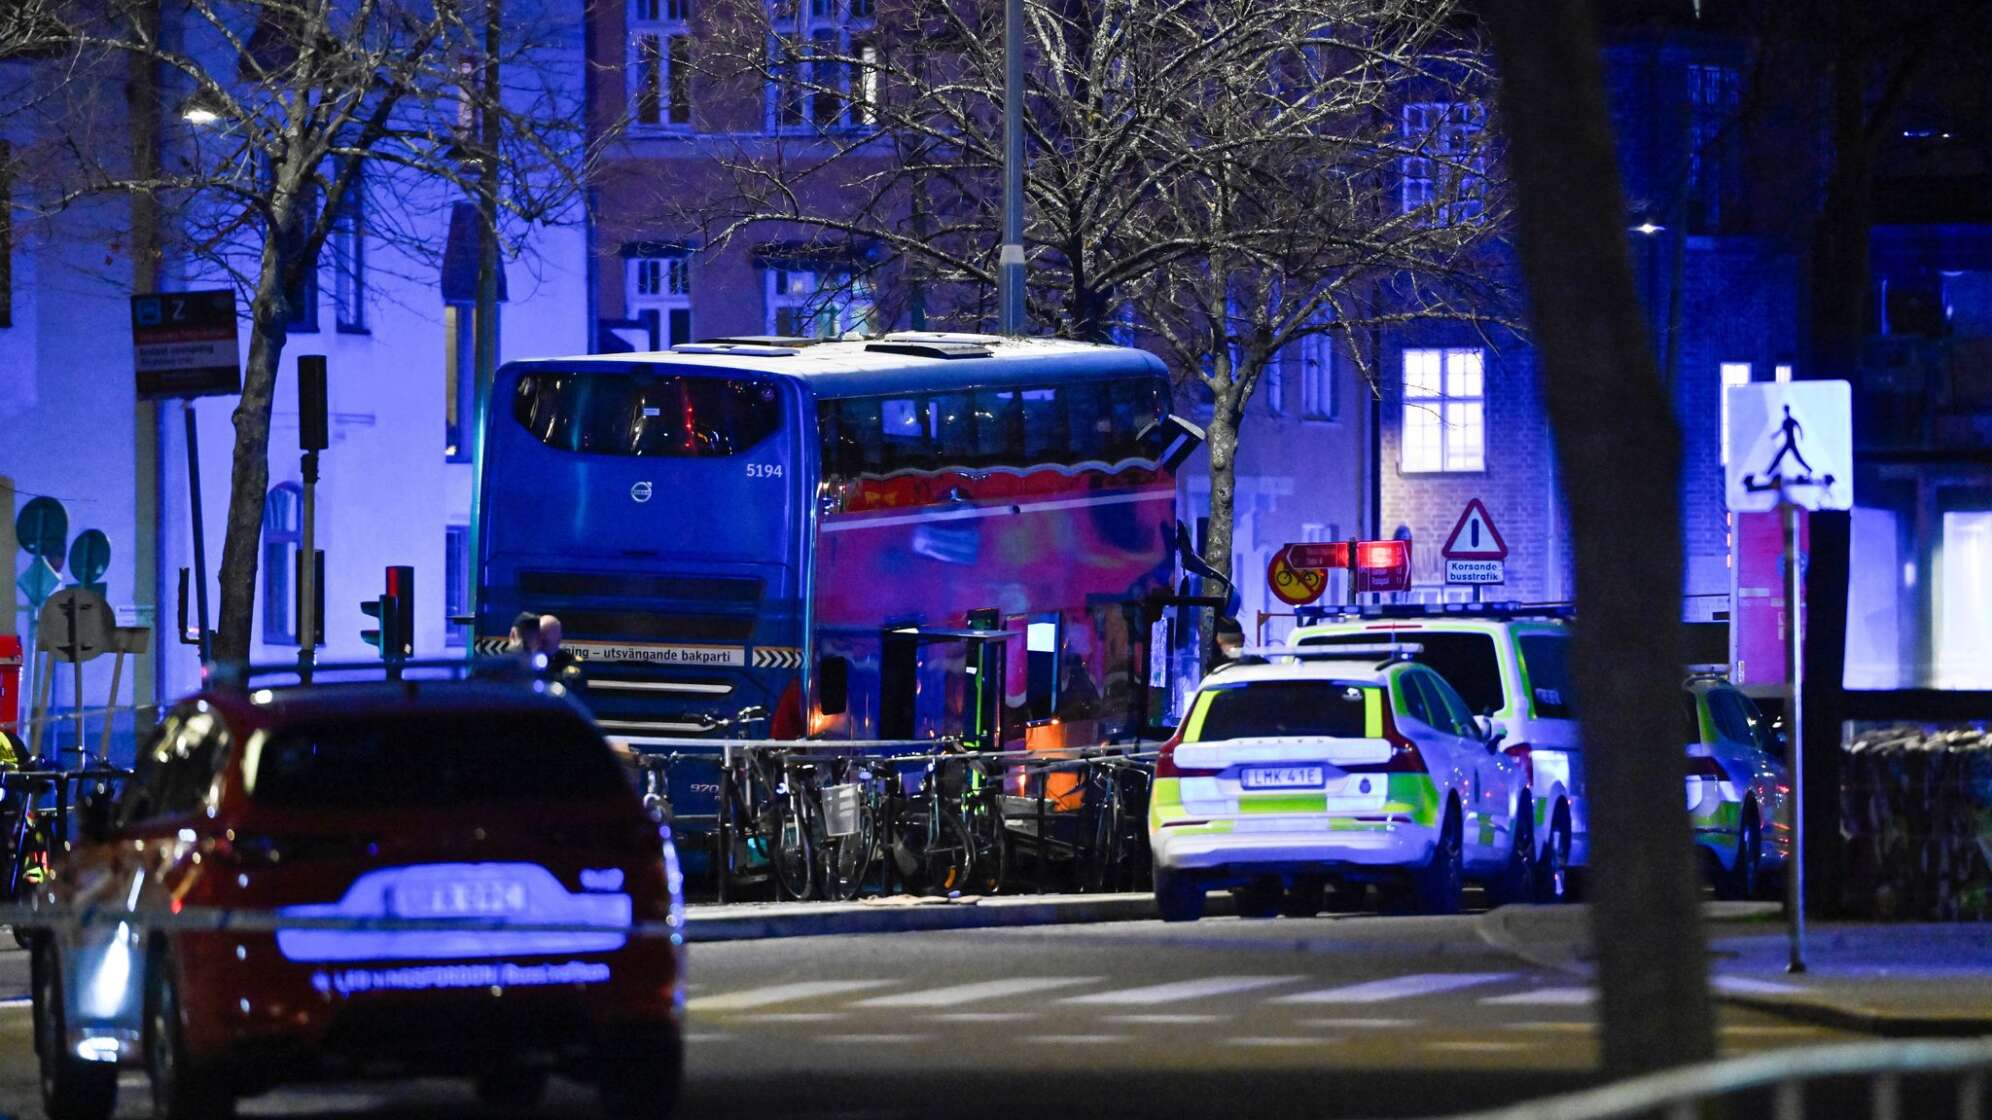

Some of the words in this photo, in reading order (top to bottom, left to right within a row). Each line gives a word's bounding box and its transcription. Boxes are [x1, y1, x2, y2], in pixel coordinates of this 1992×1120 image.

[171, 299, 186, 320] Z
[746, 464, 783, 478] 5194
[1451, 563, 1497, 571] Korsande
[603, 647, 678, 662] utsvängande
[681, 649, 731, 663] bakparti
[1254, 771, 1281, 784] LMK
